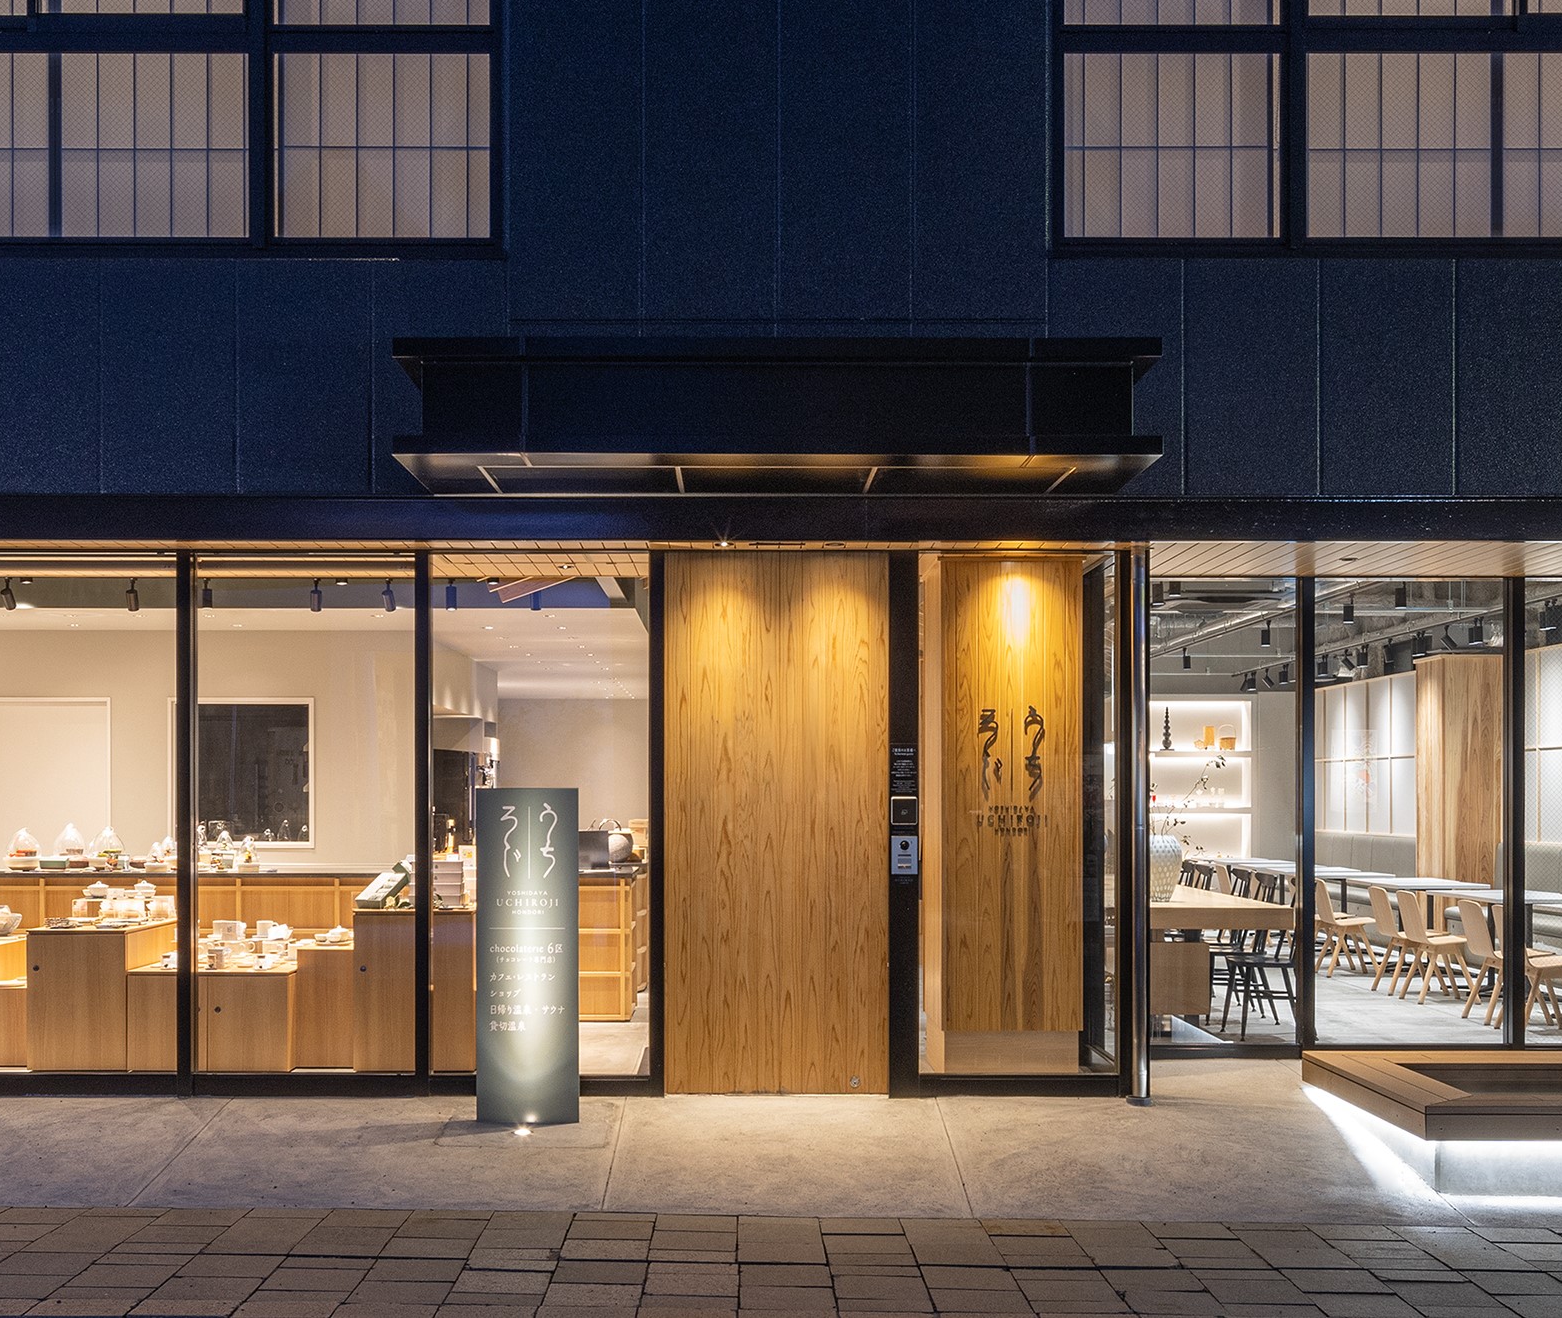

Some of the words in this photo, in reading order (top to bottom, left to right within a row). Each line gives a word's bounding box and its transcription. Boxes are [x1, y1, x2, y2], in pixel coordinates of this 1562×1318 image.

[496, 898, 559, 908] UCHIROJI
[490, 988, 521, 998] ショップ
[489, 1020, 526, 1032] 貸切温泉
